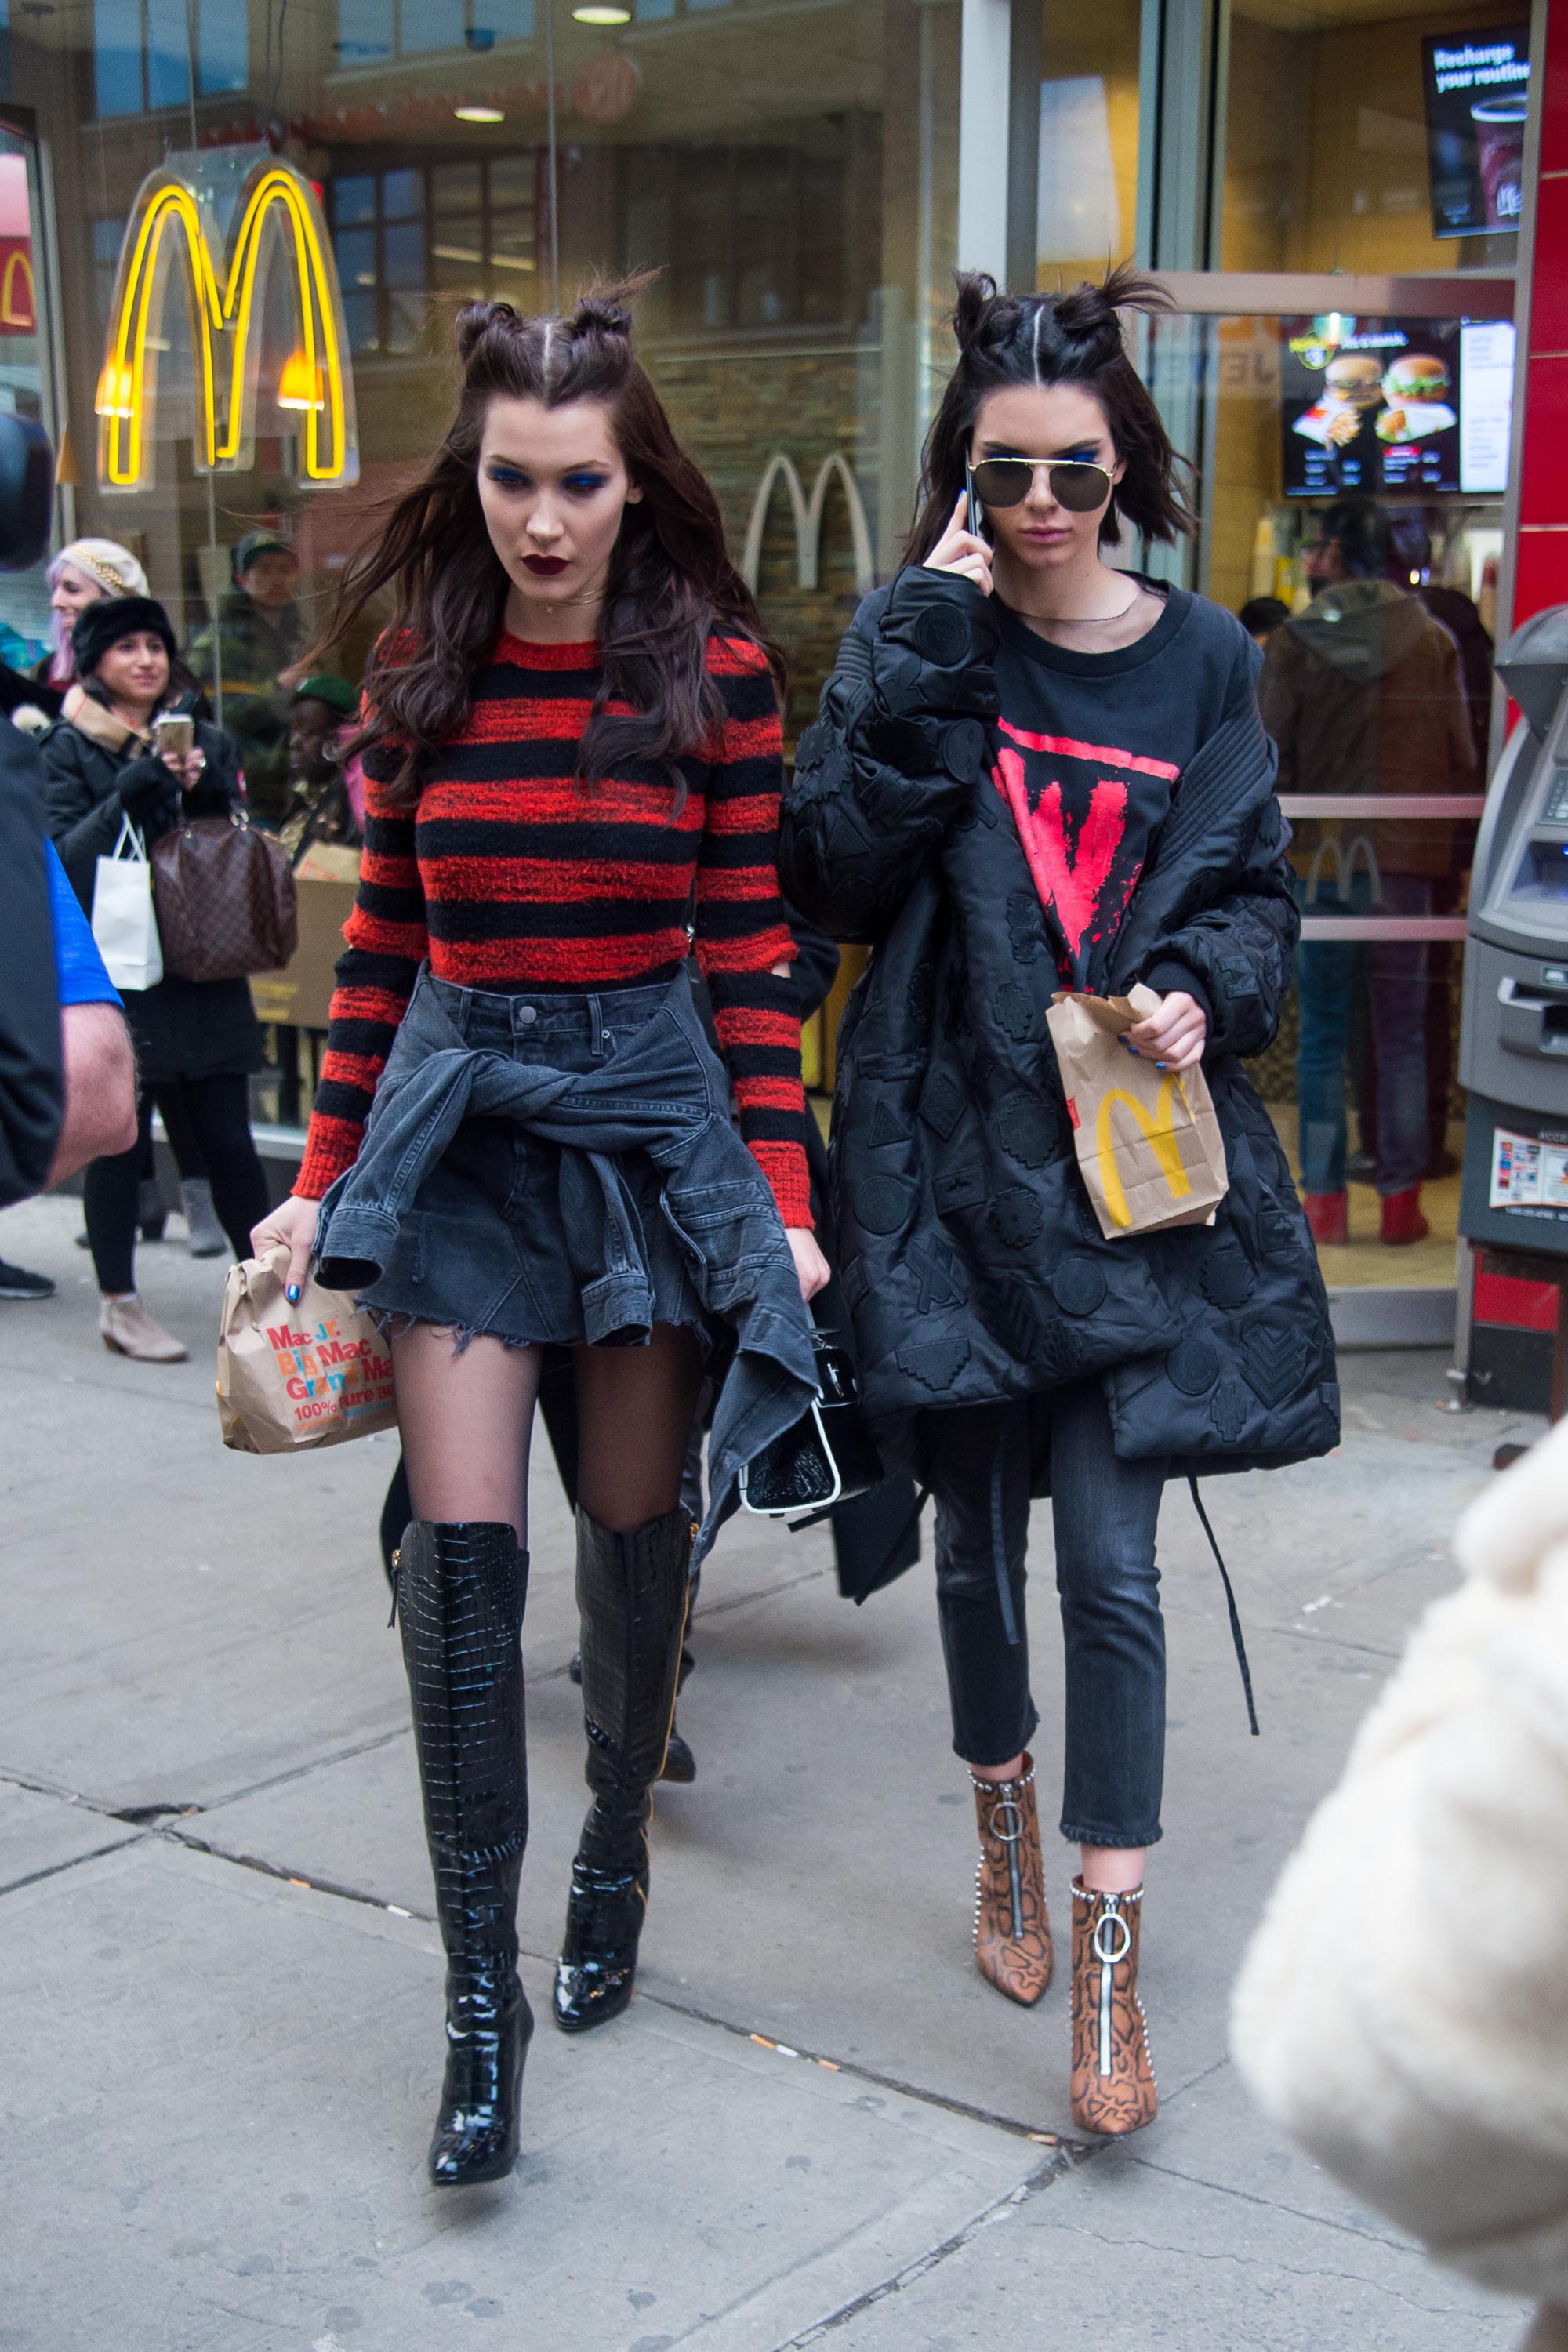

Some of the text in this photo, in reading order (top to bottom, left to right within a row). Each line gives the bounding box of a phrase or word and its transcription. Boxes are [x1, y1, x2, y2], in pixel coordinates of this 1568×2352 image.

[1434, 44, 1514, 70] Recharge
[1436, 72, 1473, 93] your
[267, 1319, 341, 1349] Mac Jr.
[278, 1339, 372, 1376] Big Mac
[286, 1355, 392, 1401] Grand Ma
[295, 1400, 336, 1420] 100%
[339, 1389, 374, 1410] pure
